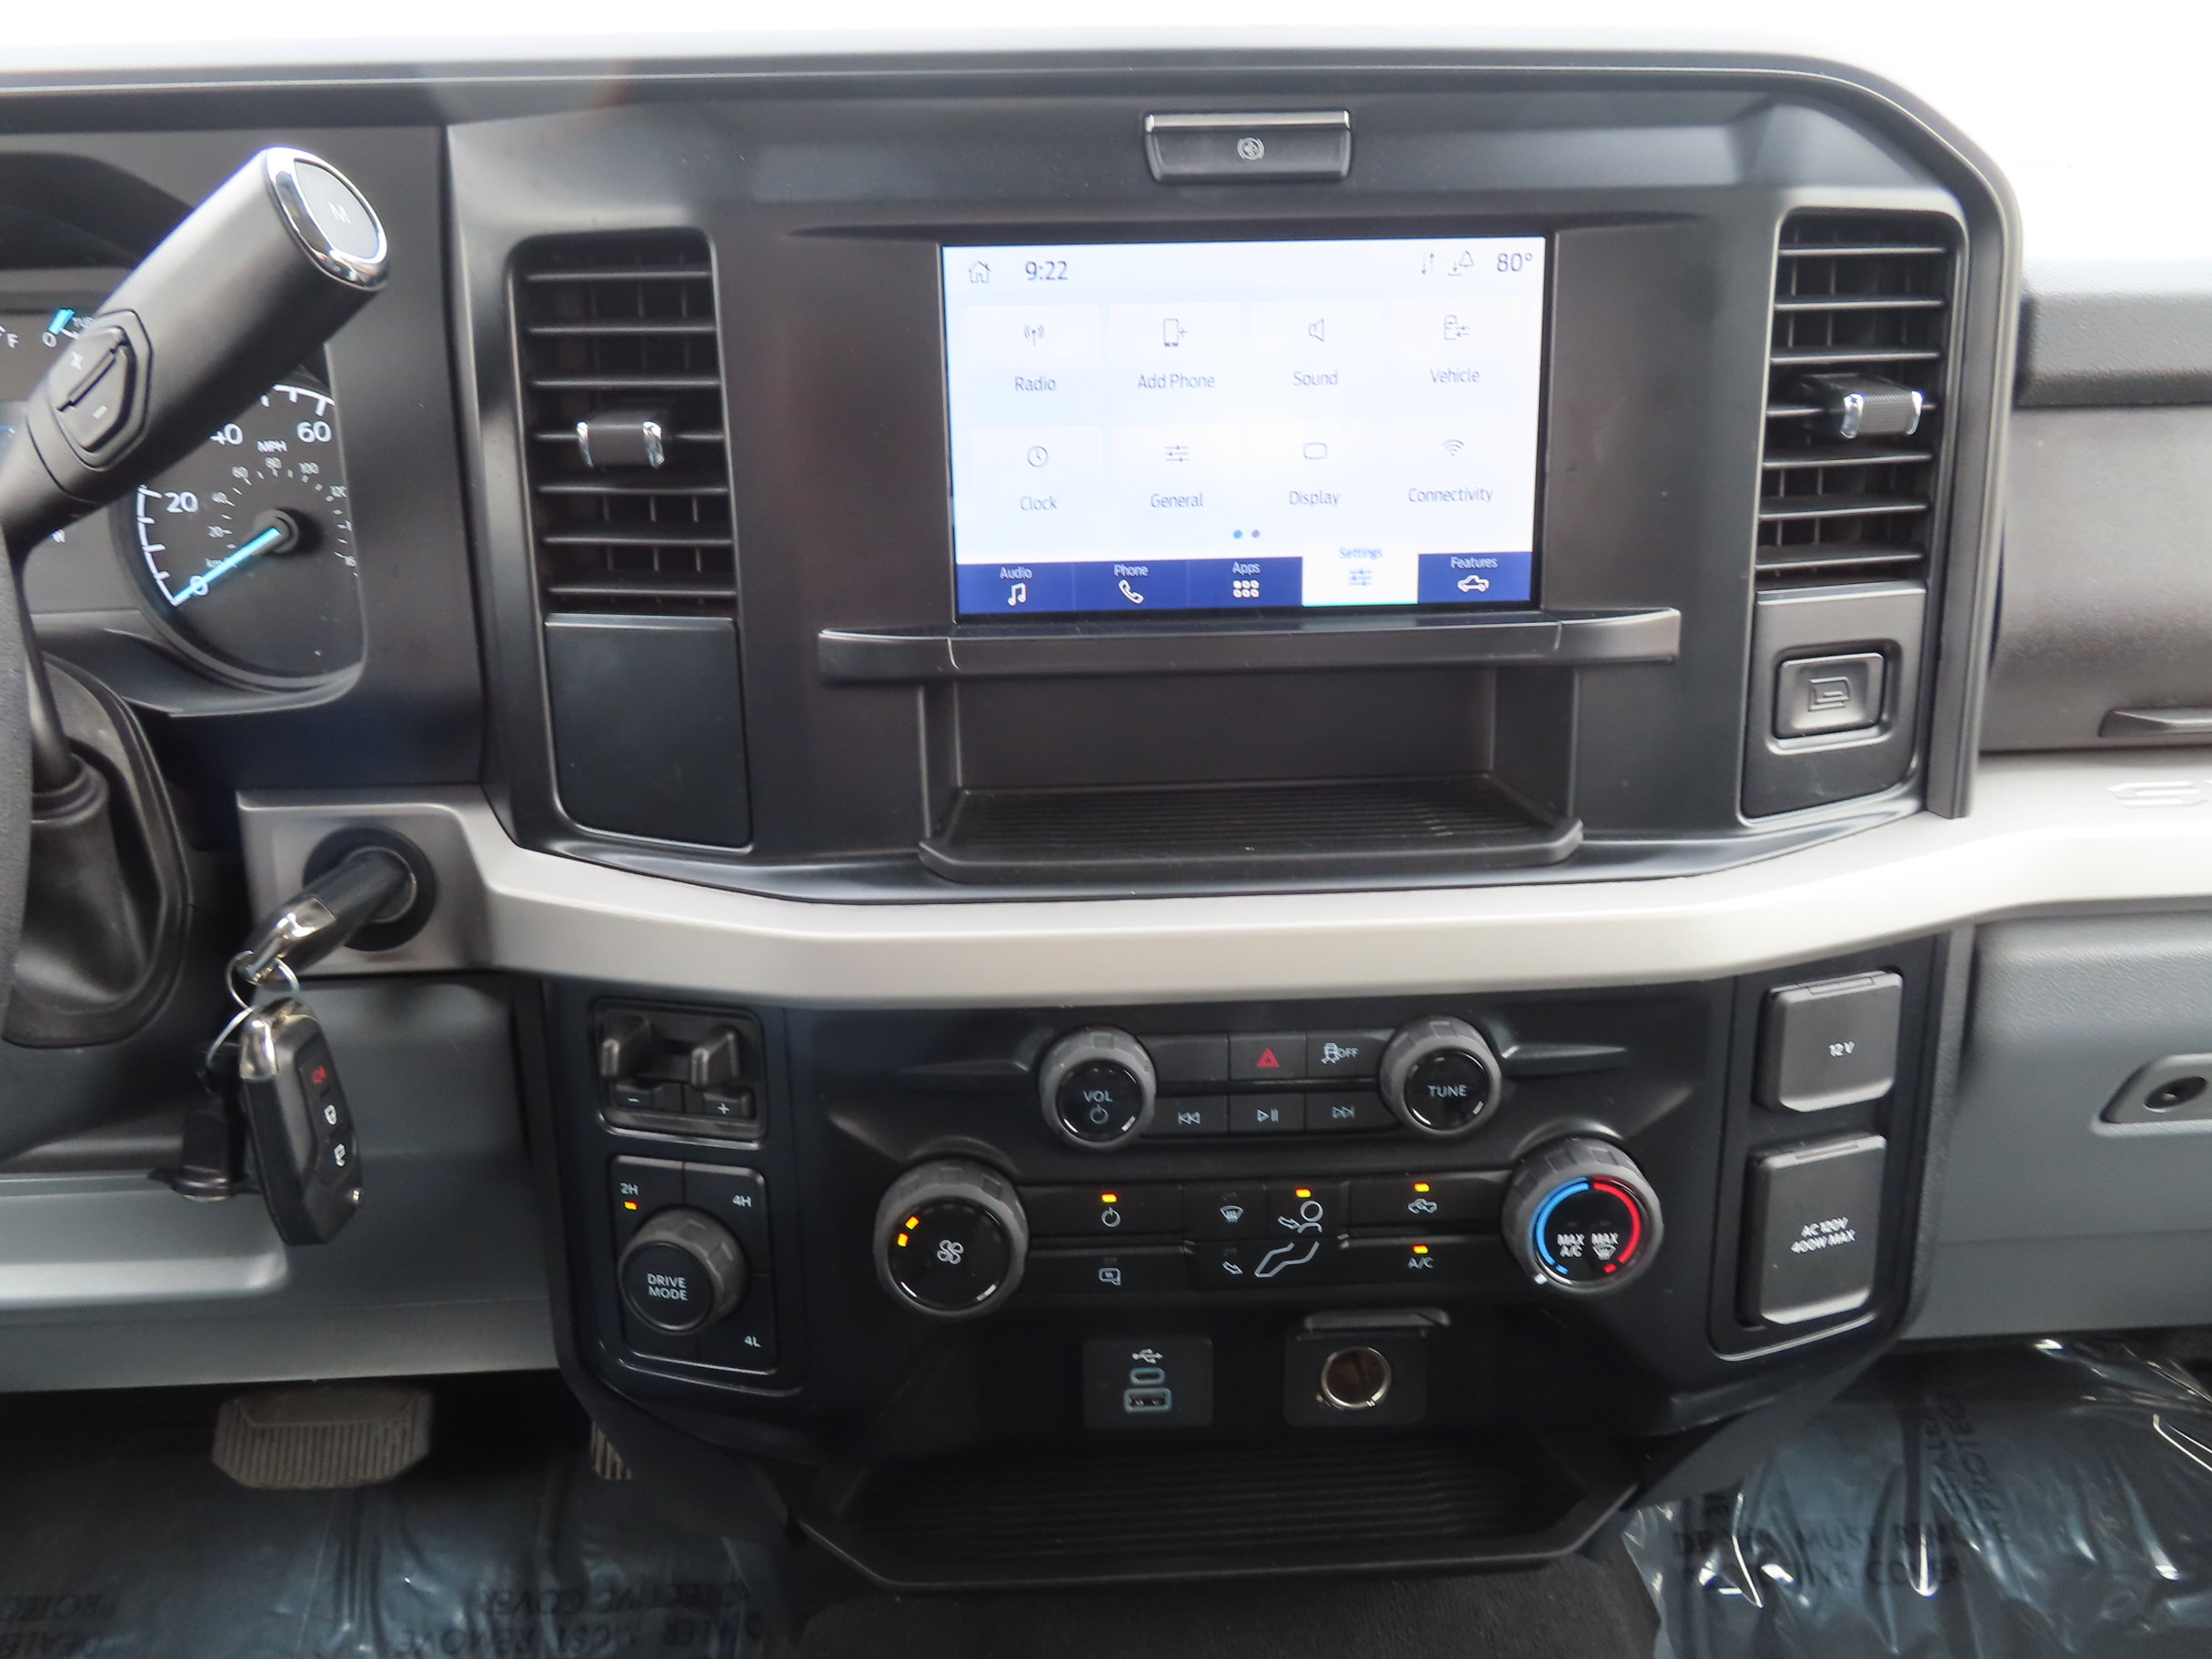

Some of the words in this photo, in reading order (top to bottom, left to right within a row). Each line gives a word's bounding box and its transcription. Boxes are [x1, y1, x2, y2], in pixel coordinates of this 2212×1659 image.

[1024, 260, 1069, 281] 9:22
[1496, 252, 1533, 273] 80°
[1014, 375, 1057, 392] Radio
[1137, 373, 1166, 389] Add
[1170, 372, 1216, 389] Phone
[1293, 369, 1339, 387] Sound
[1430, 367, 1481, 384] Vehicle
[297, 420, 332, 443] 60
[256, 440, 288, 453] MPH
[166, 491, 199, 514] 20
[1019, 495, 1058, 511] Clock
[1150, 492, 1203, 509] General
[1288, 489, 1341, 508] Display
[1407, 486, 1494, 504] Connectivity
[1338, 547, 1383, 561] Settings
[1113, 563, 1149, 578] Phone
[1232, 560, 1262, 576] Apps
[1450, 556, 1499, 569] Features
[999, 566, 1033, 580] Audio
[189, 575, 209, 596] 0
[1337, 1047, 1360, 1058] OFF
[1083, 1091, 1113, 1104] VOL
[1427, 1084, 1468, 1098] TUNE
[620, 1182, 638, 1195] 2H
[732, 1195, 751, 1208] 4H
[1556, 1233, 1584, 1246] MAX
[1591, 1232, 1619, 1245] MAX
[1827, 1229, 1856, 1247] MAX
[1560, 1245, 1583, 1258] A/C
[1408, 1257, 1433, 1270] A/C
[647, 1272, 688, 1289] DRIVE
[649, 1285, 689, 1302] MODE
[744, 1335, 762, 1348] 4L
